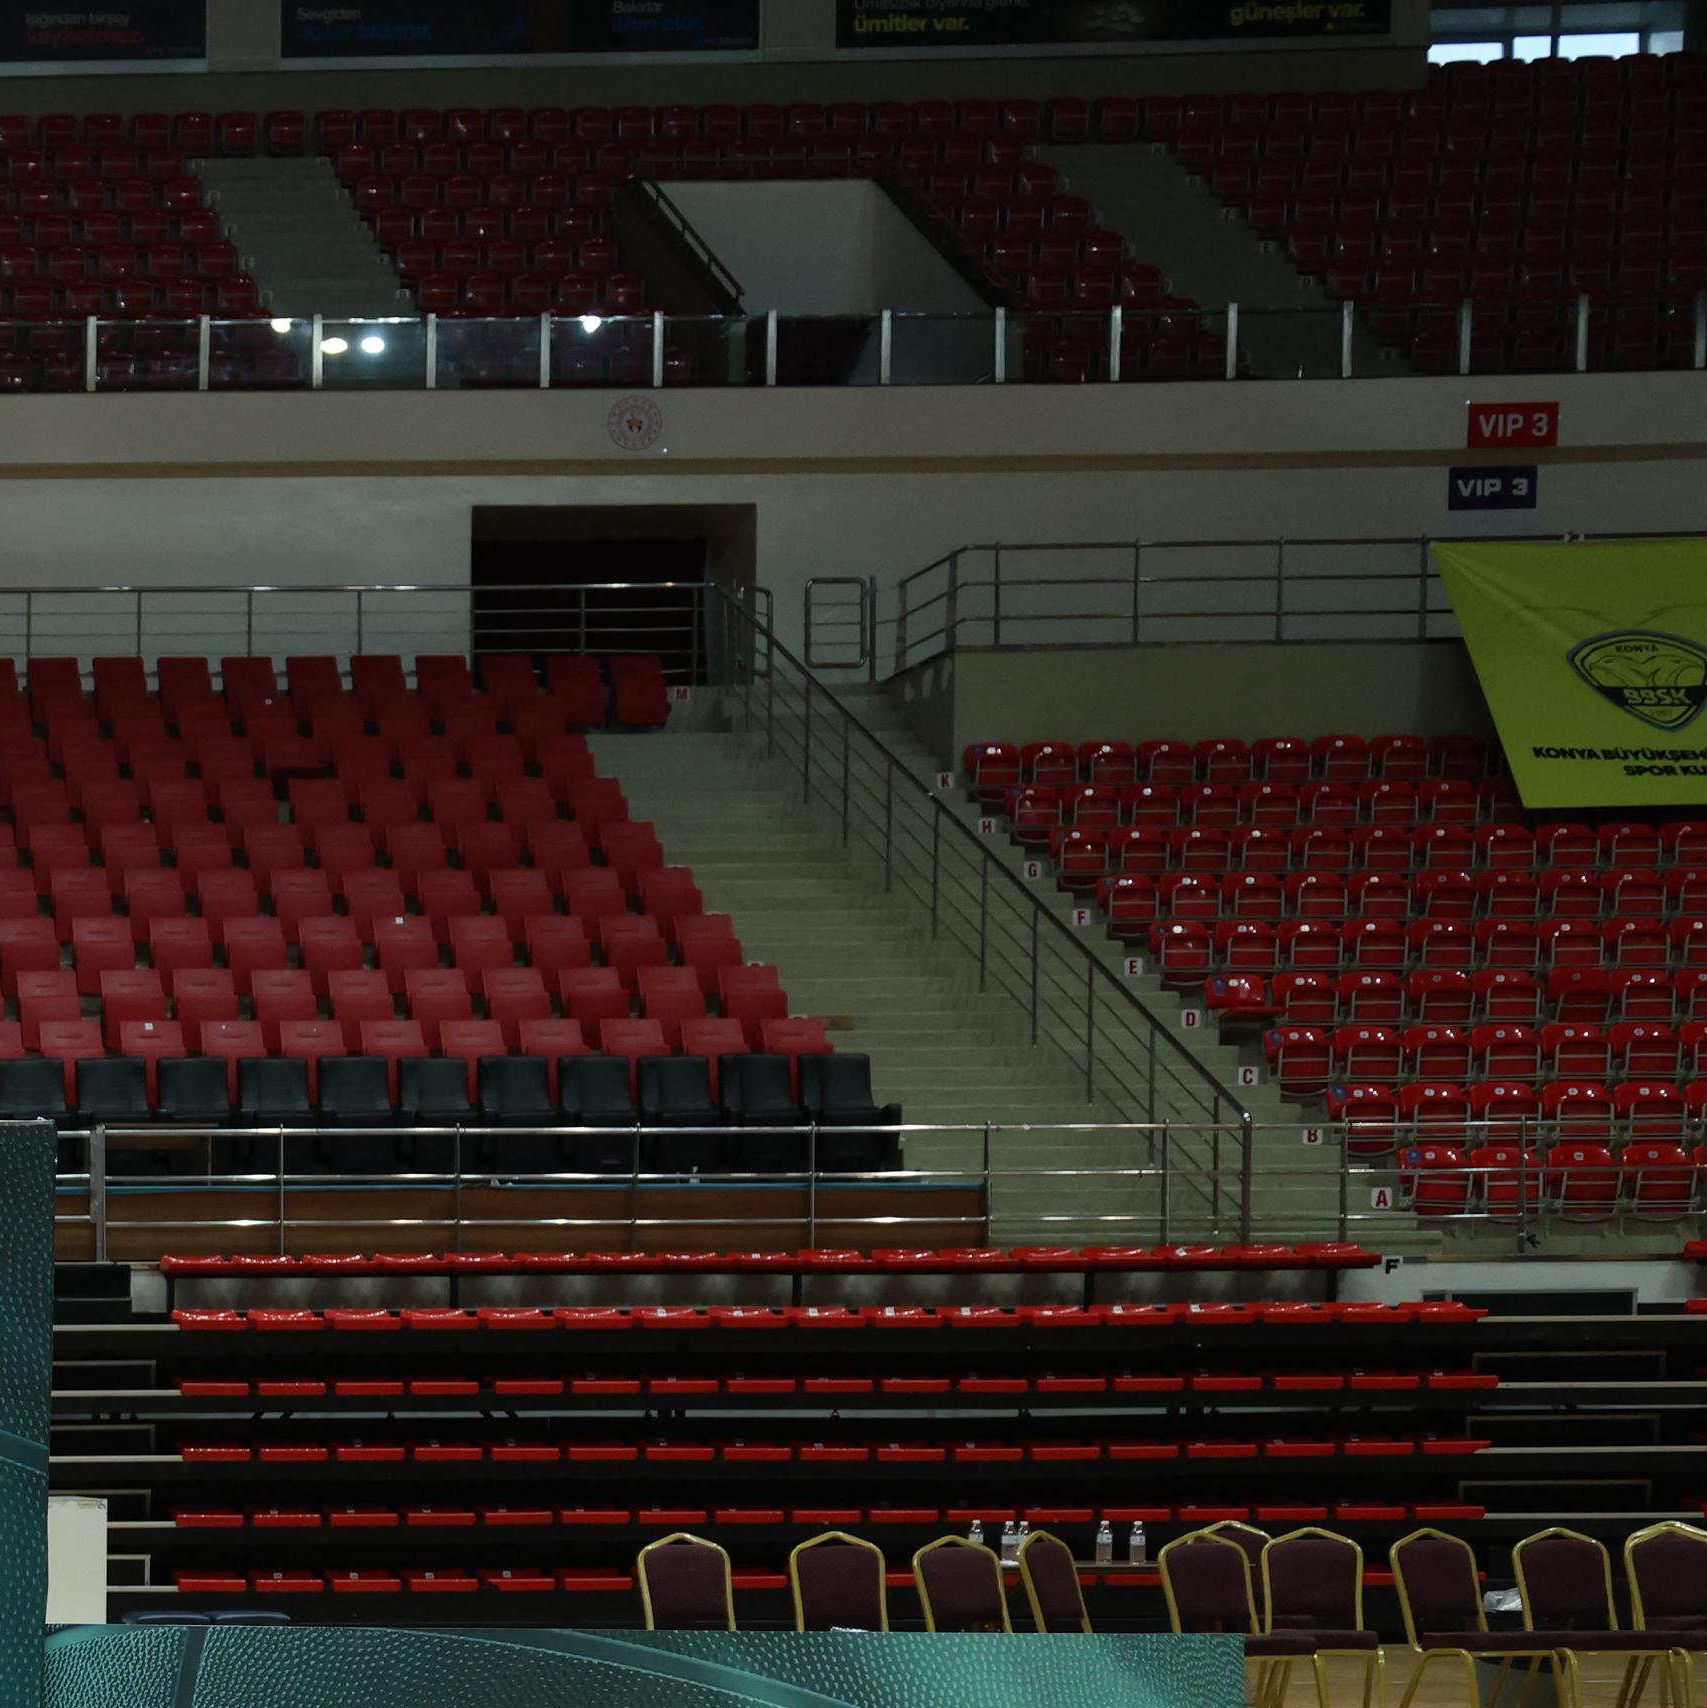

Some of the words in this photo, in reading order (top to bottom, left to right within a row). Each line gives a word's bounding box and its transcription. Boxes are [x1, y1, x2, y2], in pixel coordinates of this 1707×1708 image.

[1479, 413, 1524, 438] VIP
[1531, 412, 1550, 437] 3
[1457, 478, 1503, 497] VIP
[1511, 477, 1529, 497] 3
[1623, 688, 1691, 704] BBSK
[1532, 747, 1602, 760] KONYA
[1623, 765, 1678, 776] SPOR
[1028, 861, 1037, 877] G
[1078, 910, 1086, 924] F
[1130, 960, 1138, 974] E
[1187, 1012, 1195, 1027] D
[1243, 1068, 1253, 1084] C
[1308, 1129, 1317, 1143] B
[1376, 1189, 1387, 1207] A
[1385, 1258, 1400, 1274] F
